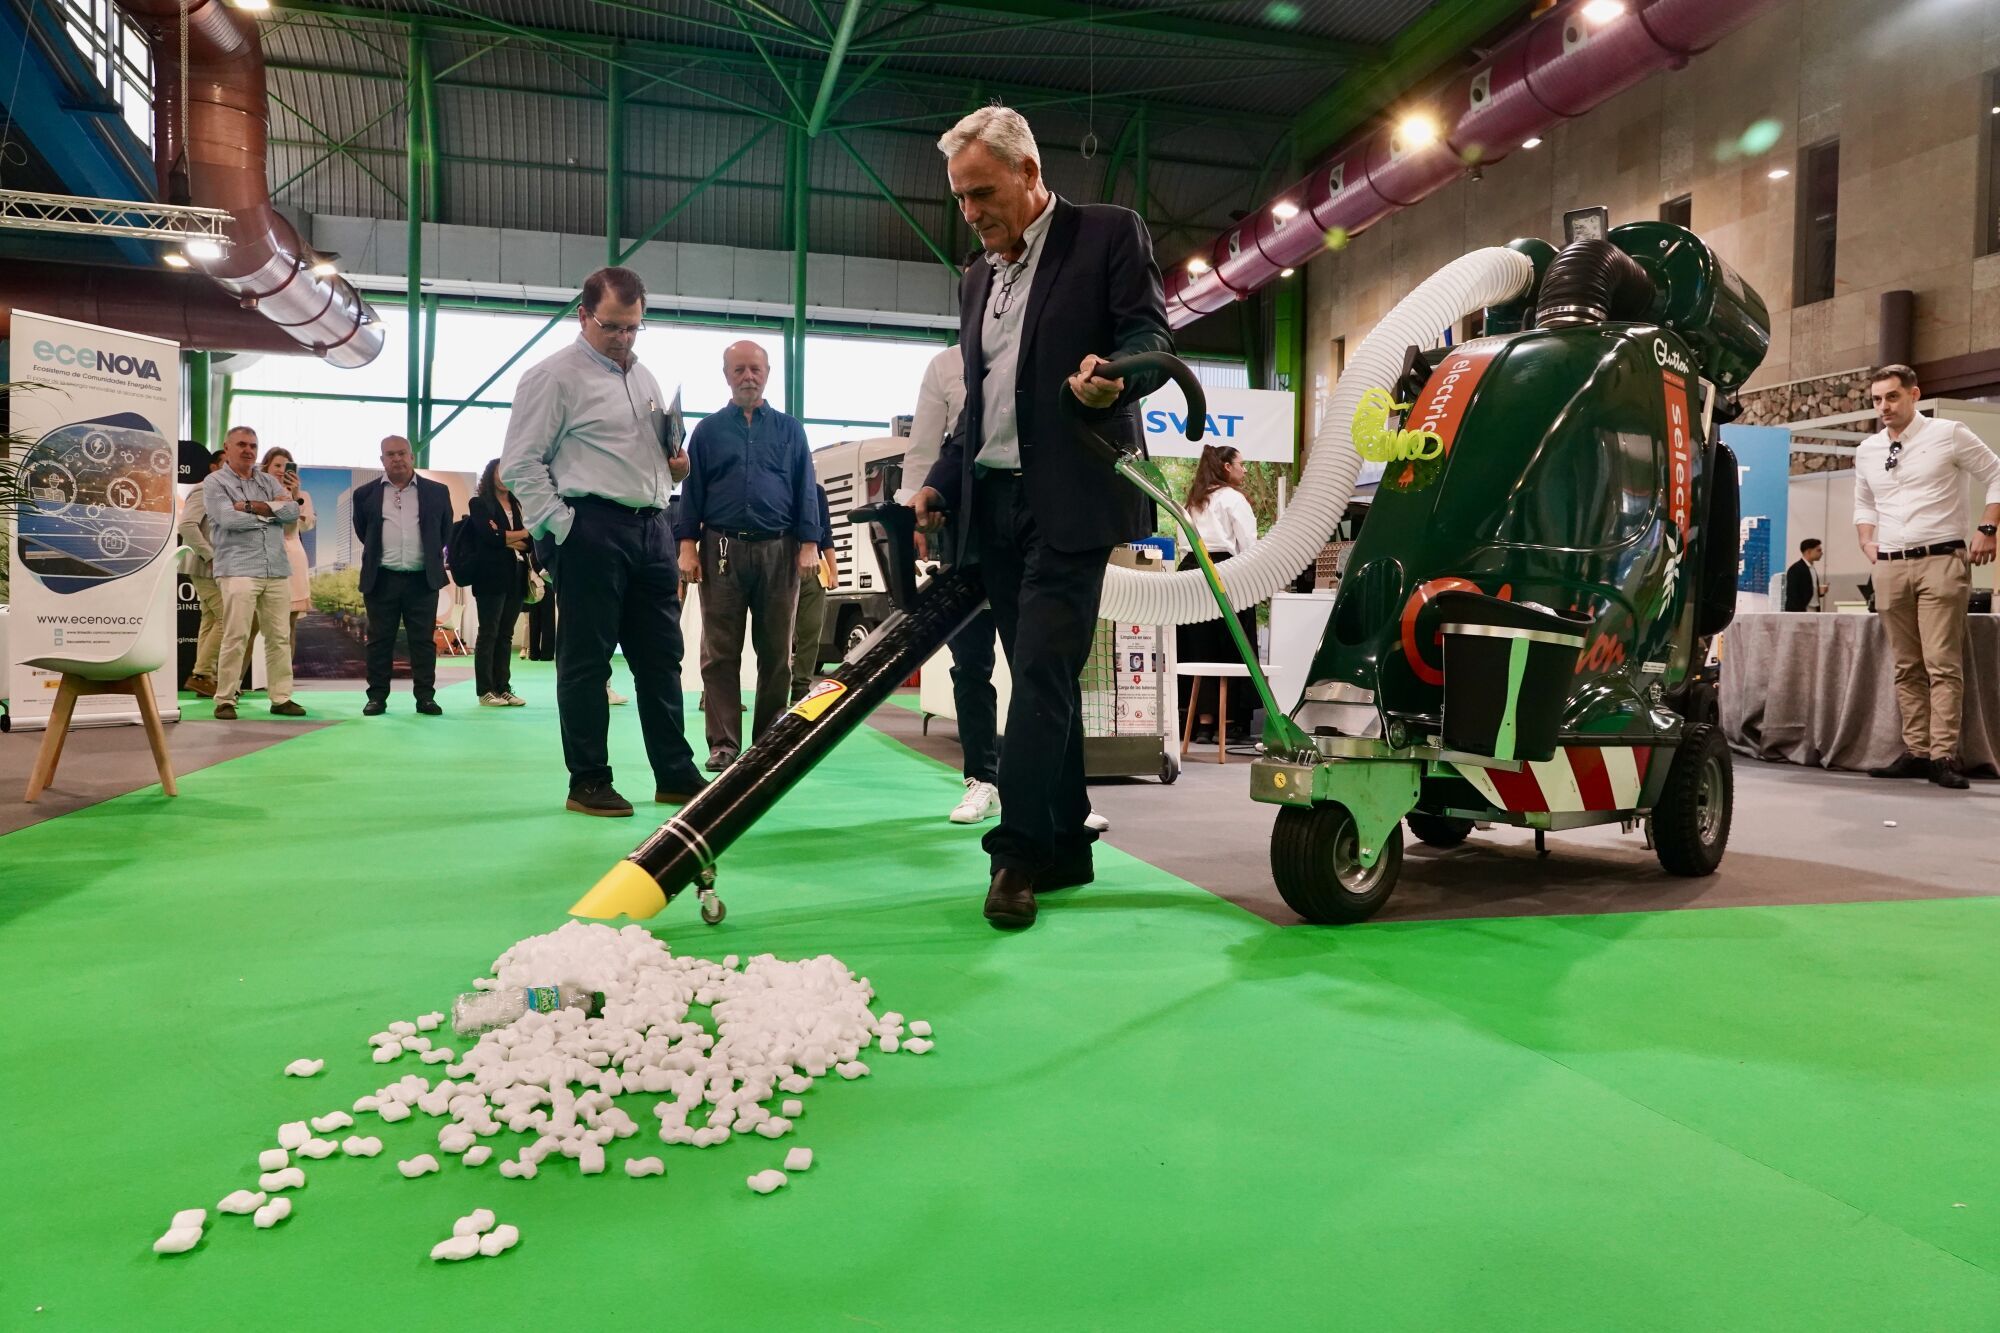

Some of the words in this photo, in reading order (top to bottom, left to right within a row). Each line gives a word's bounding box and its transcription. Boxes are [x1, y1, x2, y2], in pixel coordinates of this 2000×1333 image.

[32, 340, 162, 382] eceNOVA
[82, 372, 126, 386] Comunidades
[127, 380, 162, 392] Energéticas
[1671, 403, 1687, 527] select
